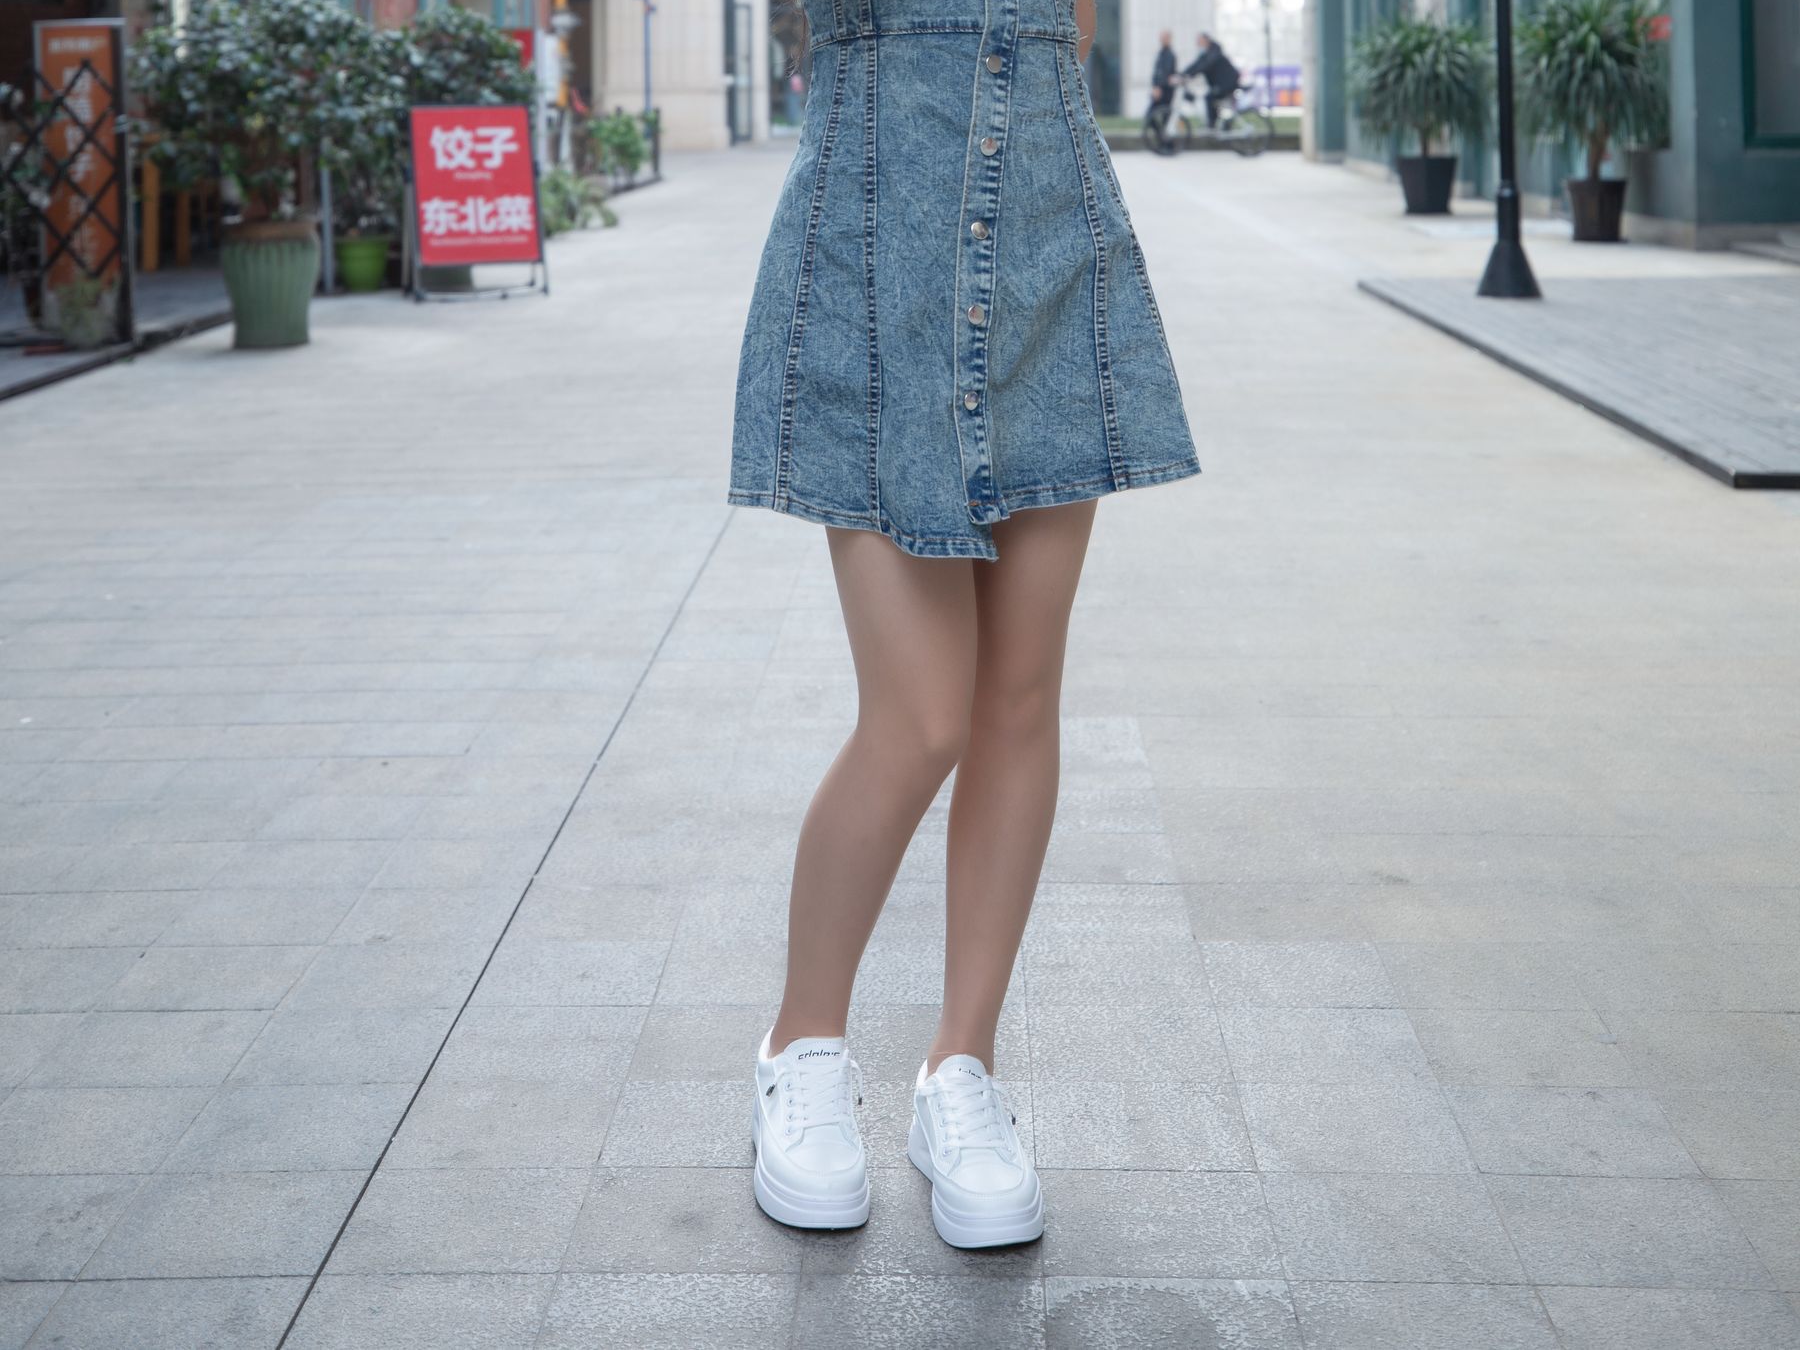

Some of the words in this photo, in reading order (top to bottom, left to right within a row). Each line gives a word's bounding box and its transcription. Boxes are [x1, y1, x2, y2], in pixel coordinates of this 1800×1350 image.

[430, 126, 519, 169] 饺子
[421, 196, 532, 234] 东北菜
